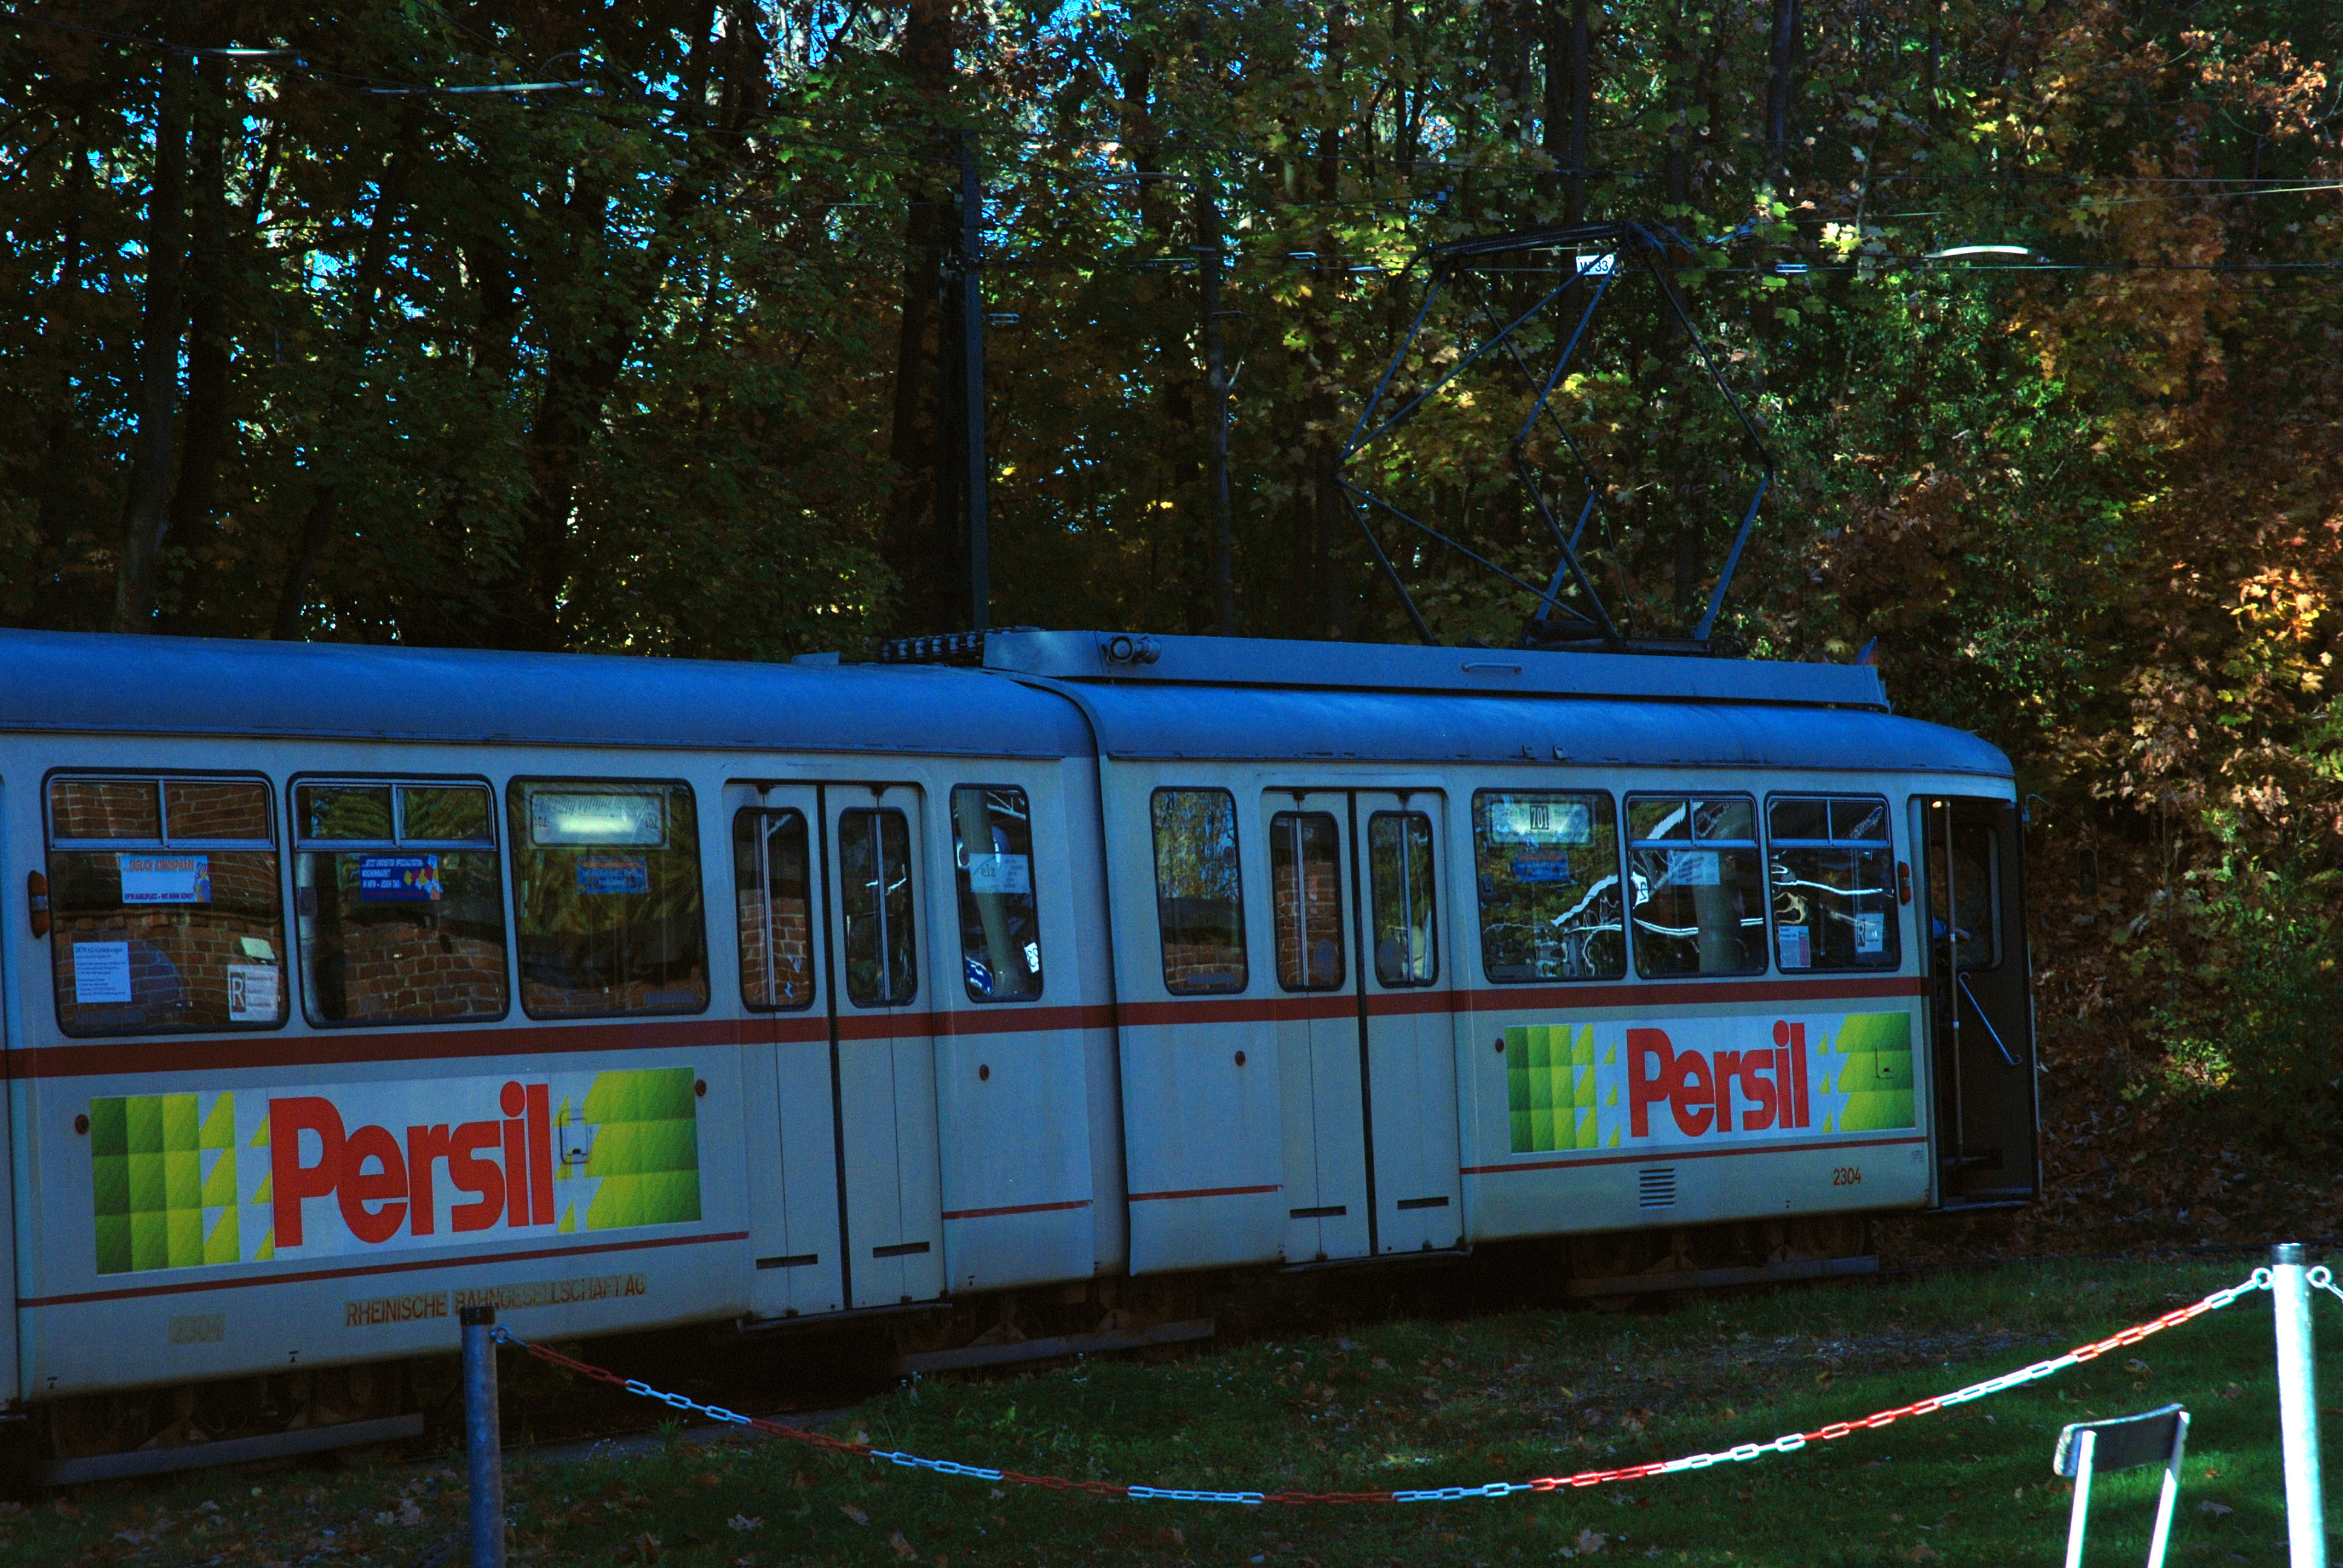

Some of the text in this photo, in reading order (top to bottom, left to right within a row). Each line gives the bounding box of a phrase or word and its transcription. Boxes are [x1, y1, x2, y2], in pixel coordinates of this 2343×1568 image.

[1595, 260, 1608, 272] 33
[1530, 806, 1548, 829] 701
[232, 976, 245, 1007] R
[1627, 1020, 1810, 1137] Persil
[269, 1080, 555, 1248] Persil
[1833, 1167, 1861, 1185] 2304
[346, 1293, 448, 1327] RHEINISCHE
